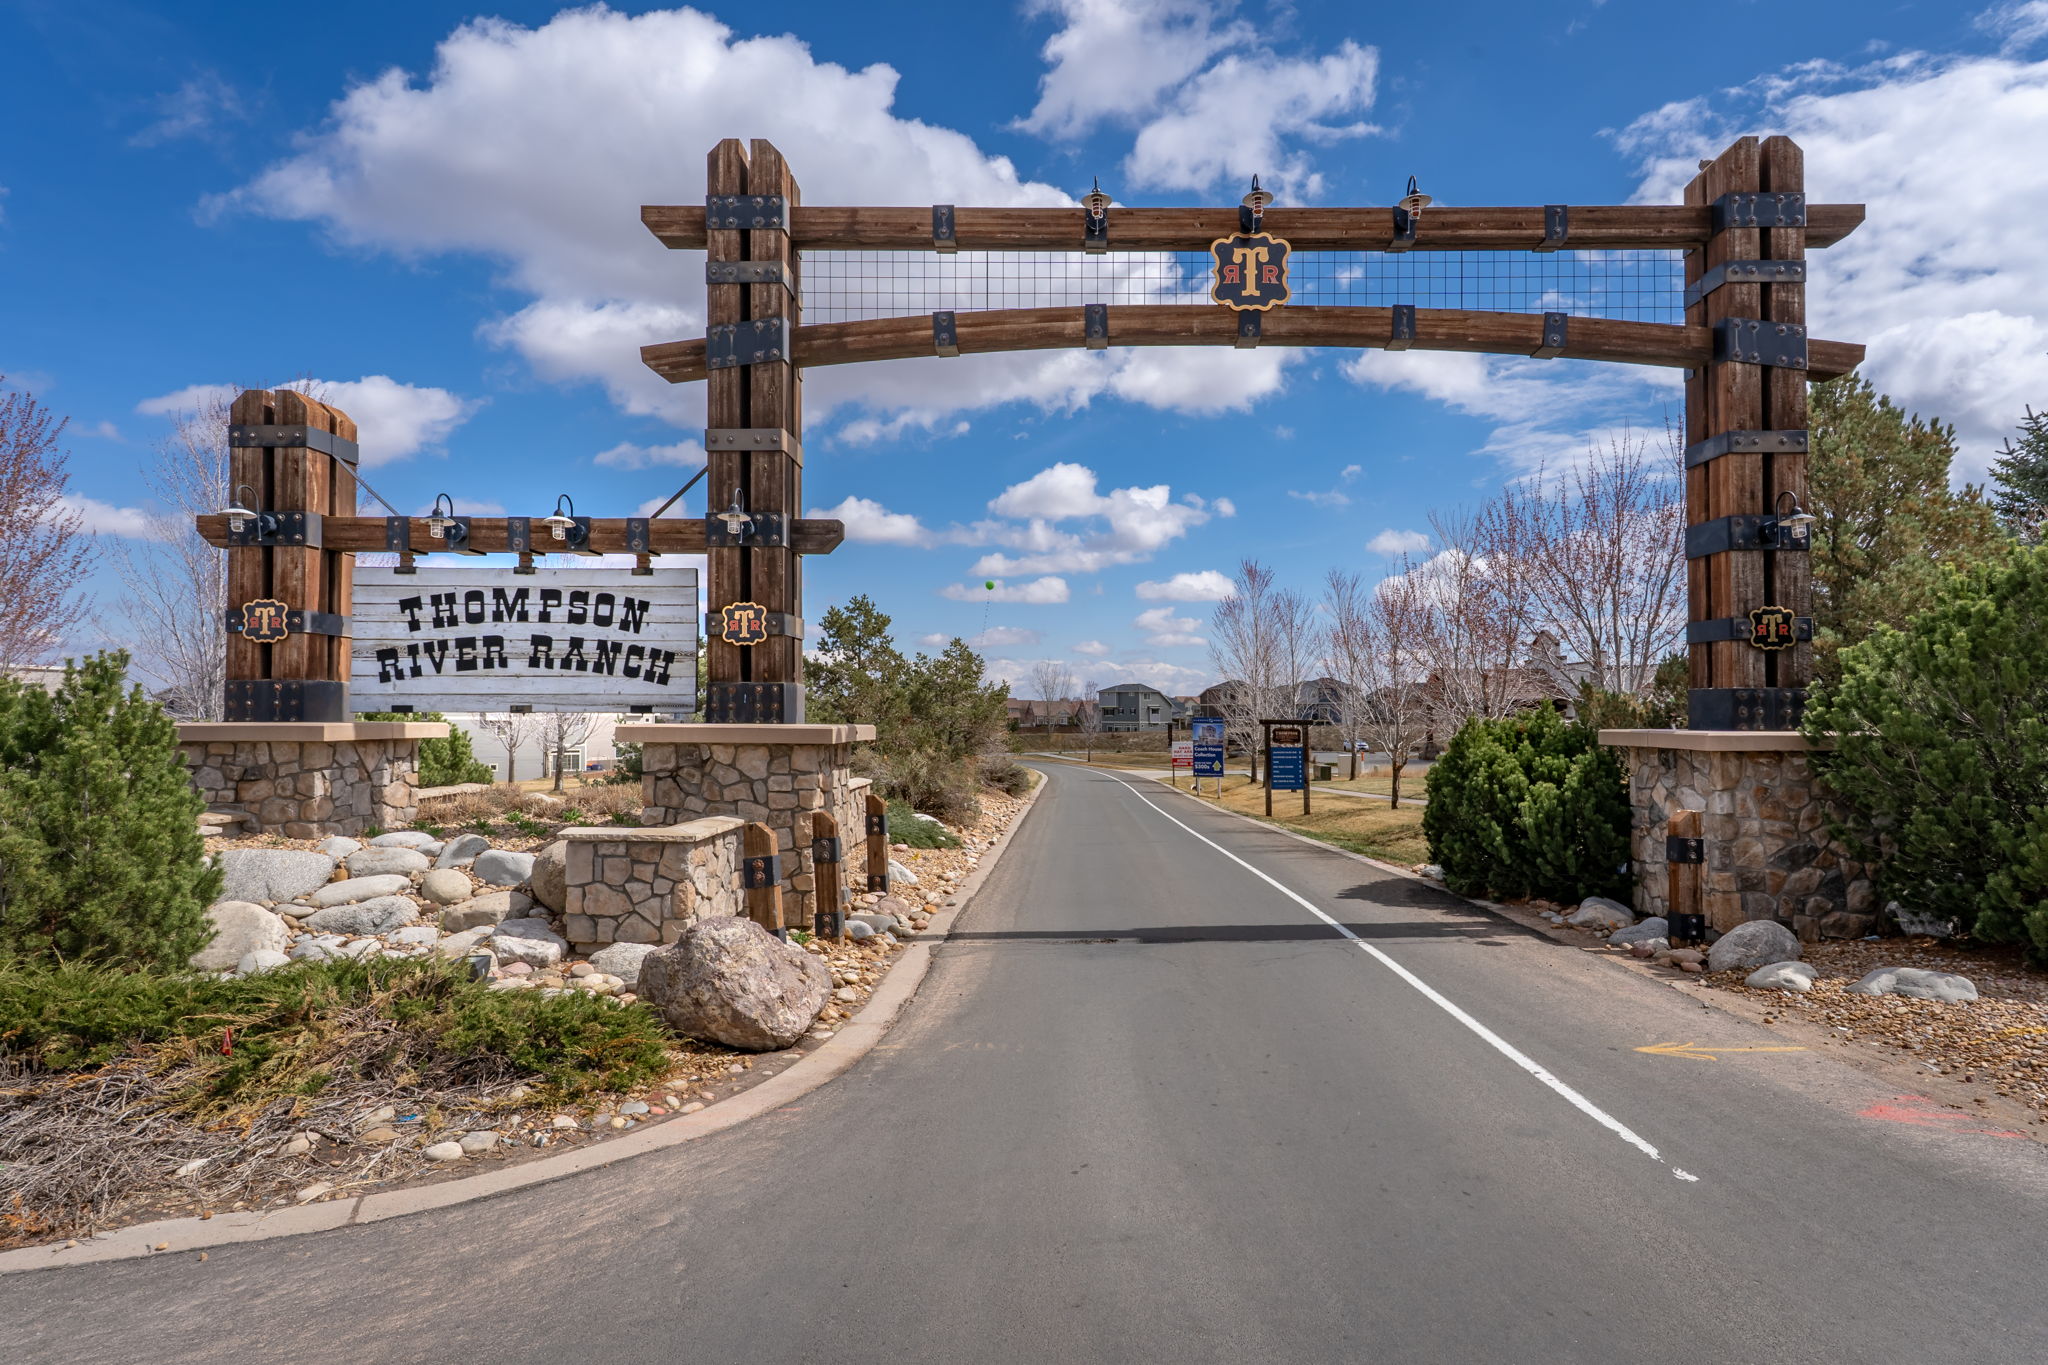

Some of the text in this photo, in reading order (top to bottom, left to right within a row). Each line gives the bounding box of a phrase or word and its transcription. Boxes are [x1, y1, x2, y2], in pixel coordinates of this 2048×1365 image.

[399, 587, 651, 635] THOMPSON
[376, 634, 676, 686] RIVER RANCH
